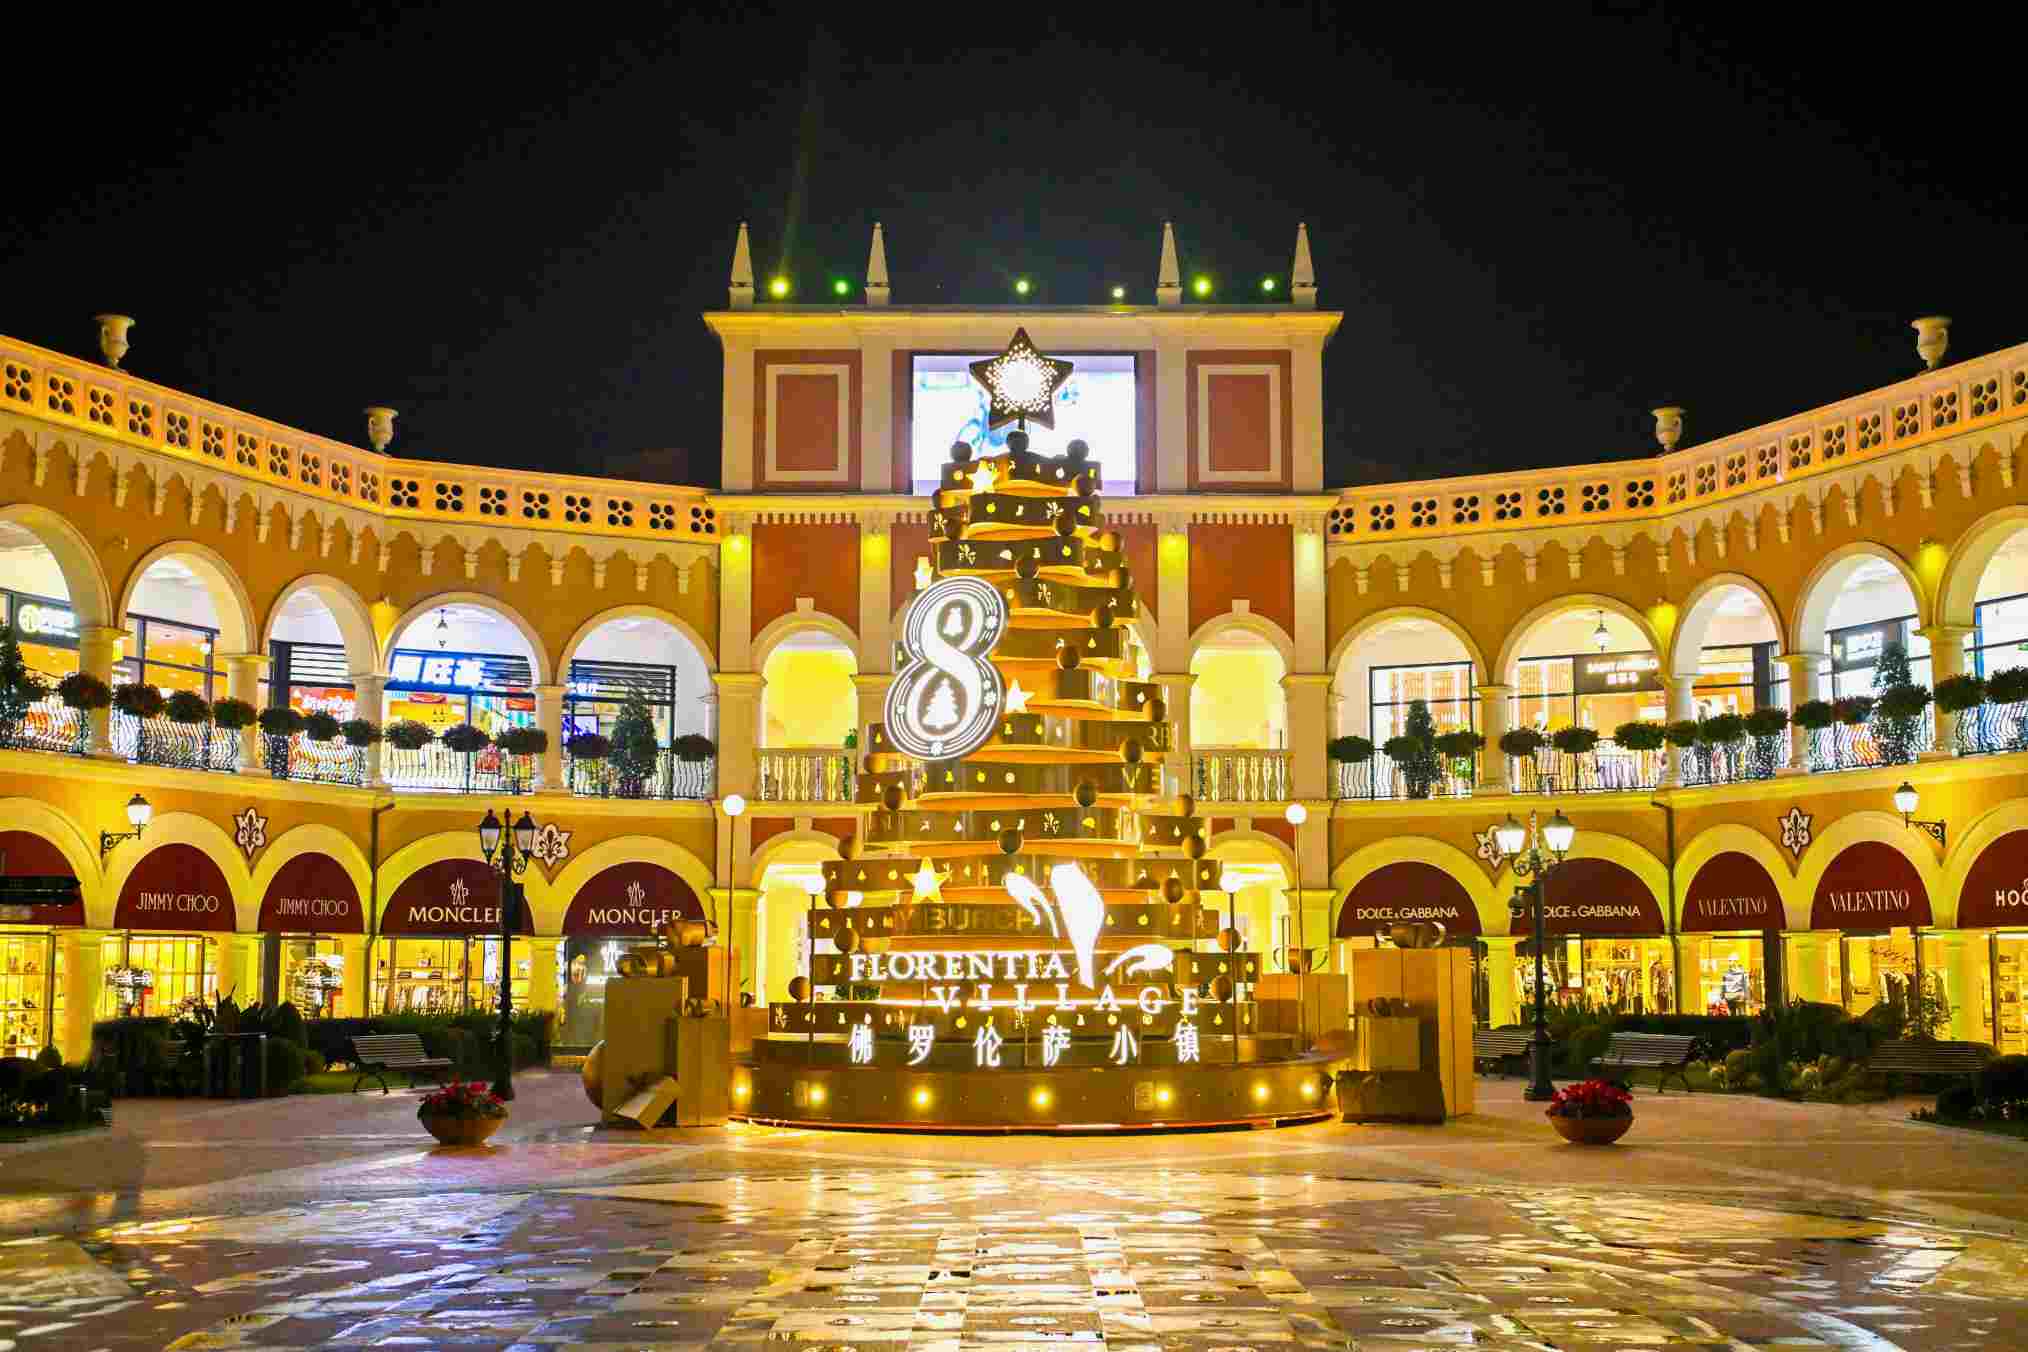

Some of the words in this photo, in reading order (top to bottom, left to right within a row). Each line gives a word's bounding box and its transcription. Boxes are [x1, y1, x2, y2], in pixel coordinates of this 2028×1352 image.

[136, 893, 173, 913] JIMMY
[177, 894, 219, 913] CHOO
[276, 898, 310, 916] JIMMY
[312, 899, 349, 916] CHOO
[1698, 897, 1767, 917] VALENTINO
[1829, 889, 1910, 913] VALENTINO
[849, 952, 1070, 982] FLORENTIA
[933, 984, 1200, 1015] VILLAGE
[848, 1023, 1201, 1067] 佛罗伦萨小镇
